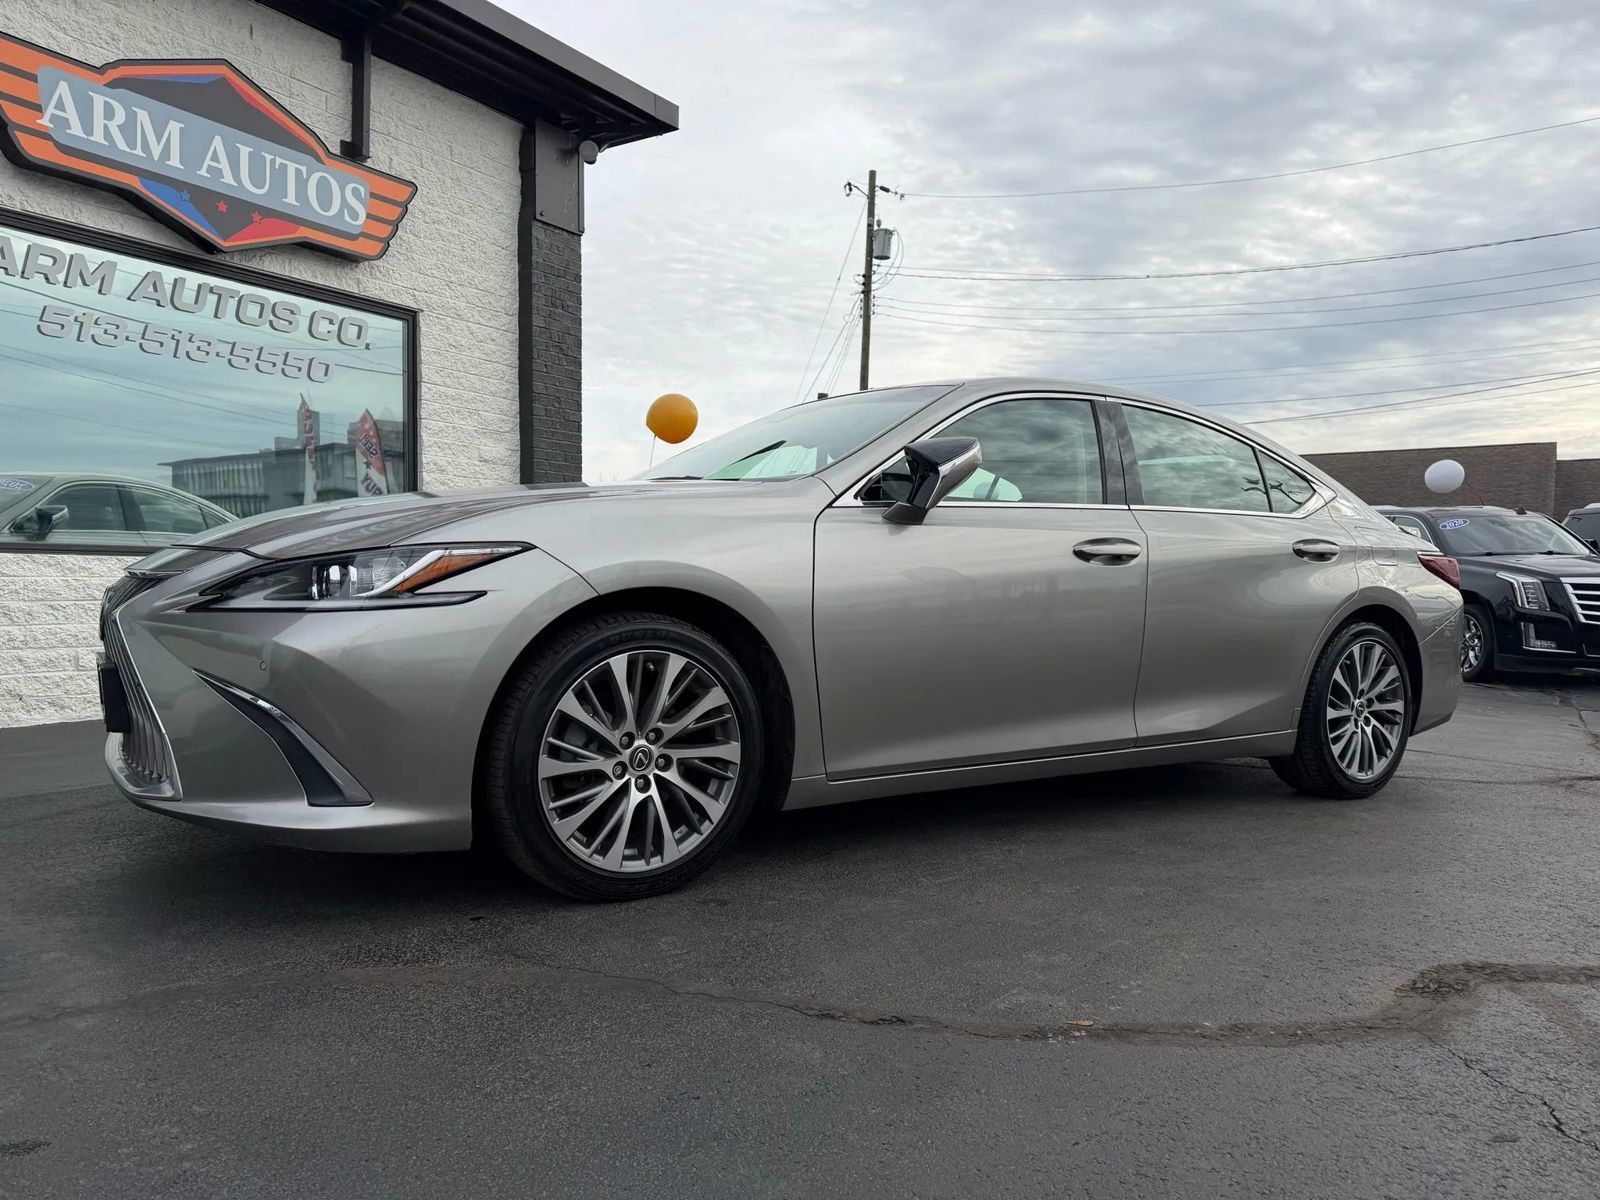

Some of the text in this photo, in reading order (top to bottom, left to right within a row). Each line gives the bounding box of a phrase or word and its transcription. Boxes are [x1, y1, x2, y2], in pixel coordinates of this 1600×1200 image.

[36, 80, 367, 226] ARM AUTOS
[36, 304, 336, 384] 513-513-5550
[127, 270, 303, 334] AUTOS
[308, 310, 373, 350] CO.
